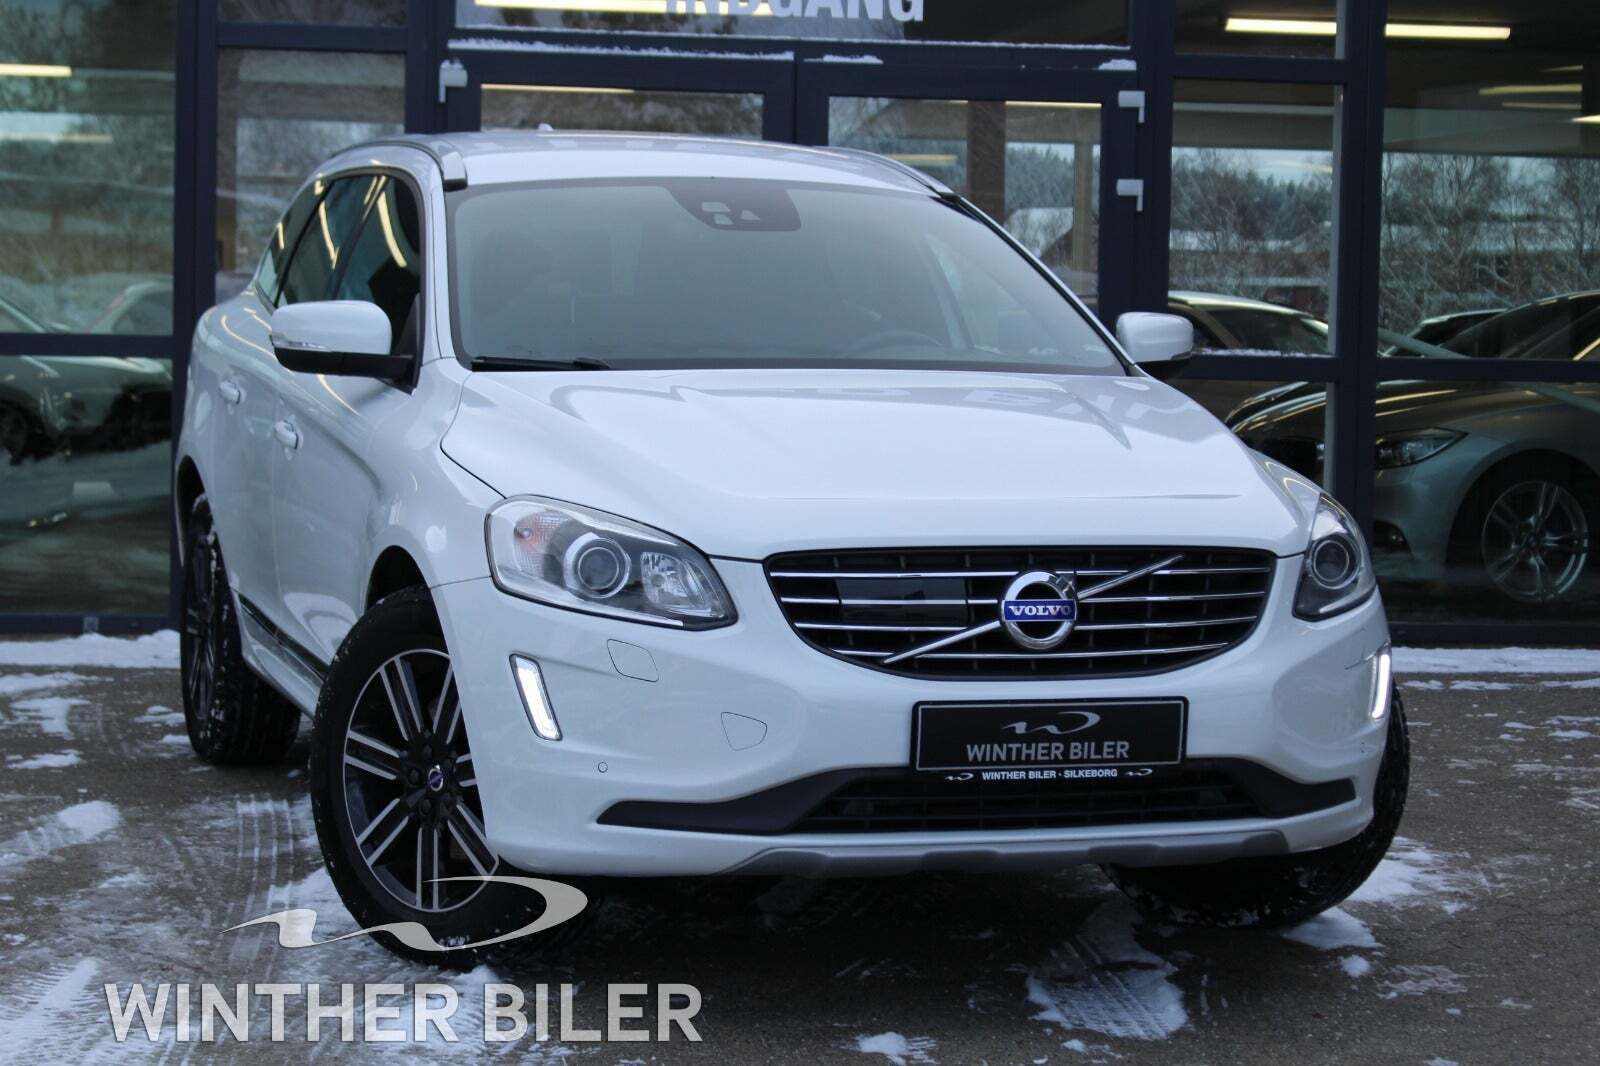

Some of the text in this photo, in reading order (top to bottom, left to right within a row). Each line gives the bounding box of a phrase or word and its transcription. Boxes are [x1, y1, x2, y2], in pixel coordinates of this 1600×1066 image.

[1008, 605, 1073, 616] VOLVO
[966, 741, 1130, 762] WINTHER BILER
[982, 768, 1118, 780] WINTHER BILER SILKEBORG
